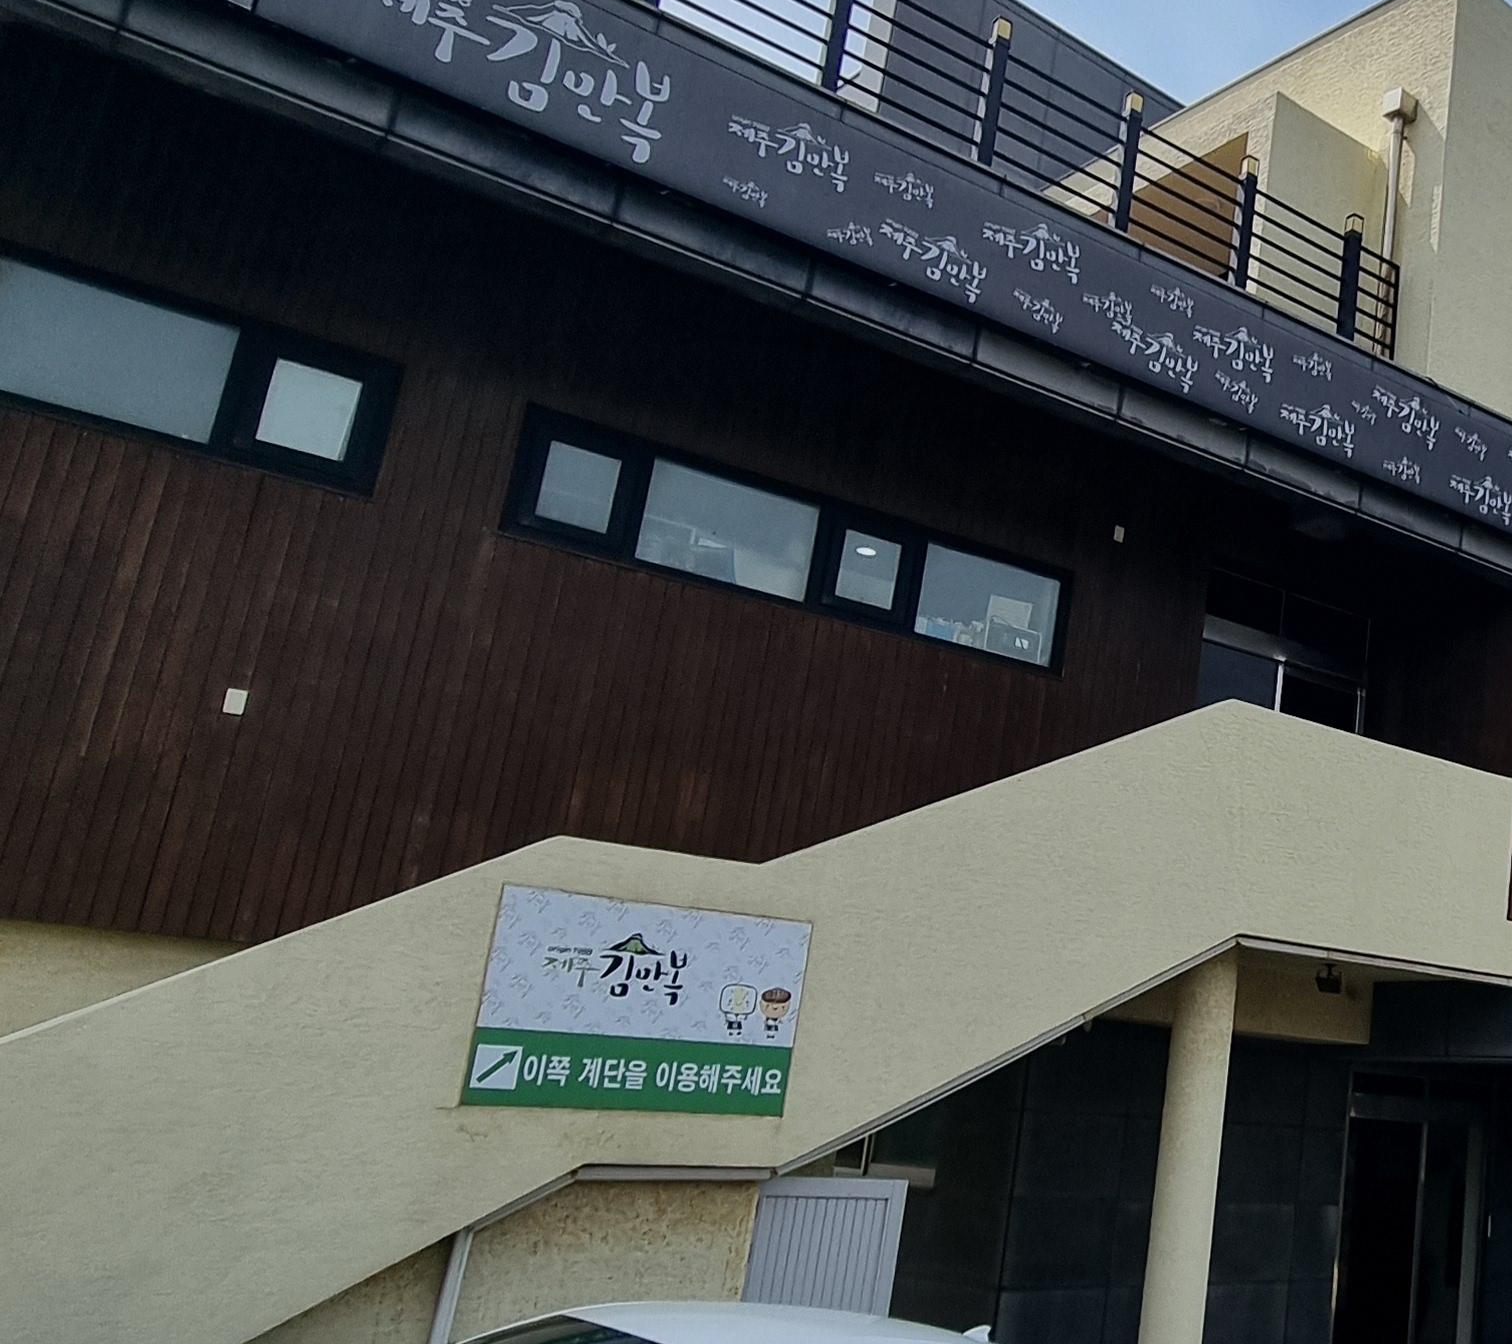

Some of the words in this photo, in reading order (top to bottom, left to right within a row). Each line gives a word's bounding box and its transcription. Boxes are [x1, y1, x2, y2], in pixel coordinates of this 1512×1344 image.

[523, 1054, 571, 1087] 이쪽
[578, 1057, 648, 1091] 계단을
[655, 1061, 782, 1096] 이용해주세요
